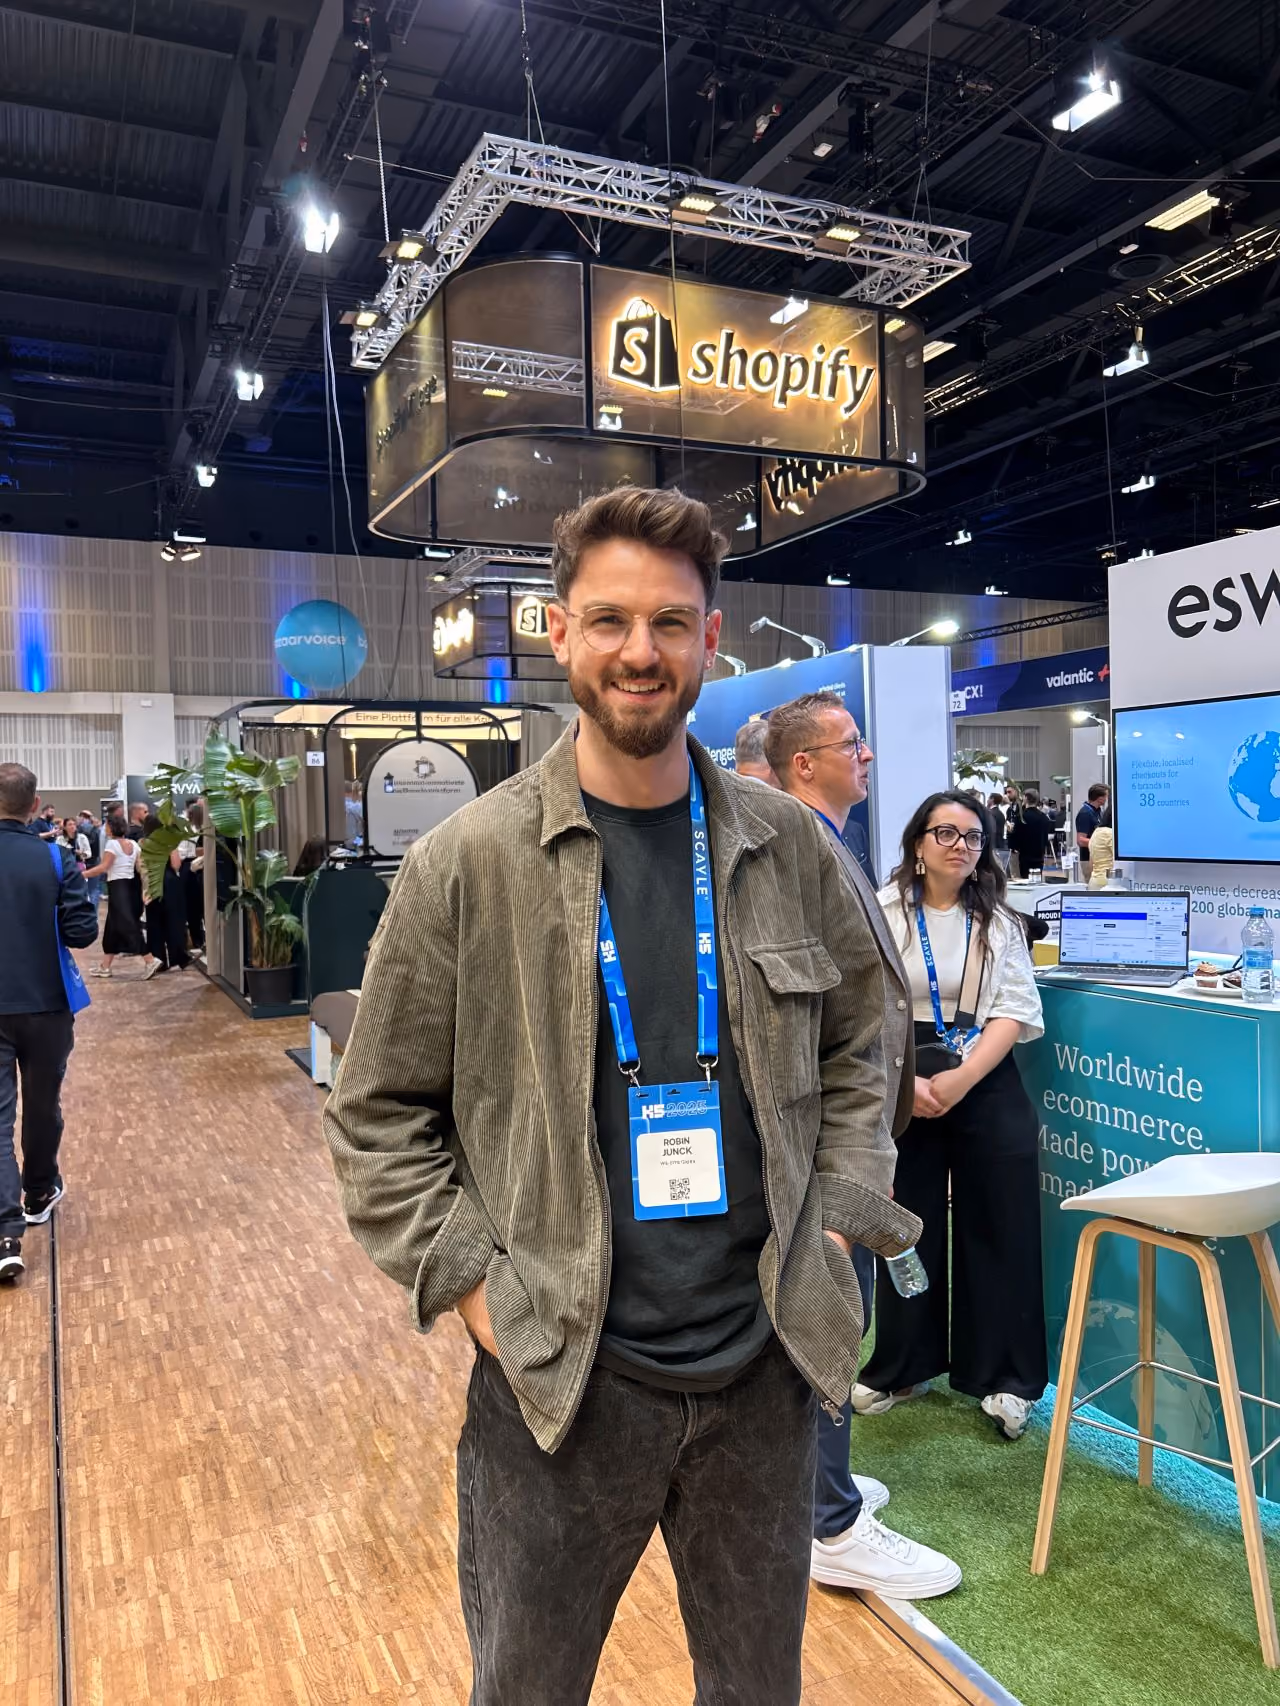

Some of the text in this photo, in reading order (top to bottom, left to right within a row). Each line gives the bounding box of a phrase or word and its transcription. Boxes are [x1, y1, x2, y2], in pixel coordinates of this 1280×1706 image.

[687, 328, 876, 419] shopify
[1046, 667, 1094, 688] valantic
[965, 684, 984, 699] CX!
[953, 700, 962, 710] 72
[355, 712, 379, 721] Eine
[436, 714, 451, 722] für
[454, 714, 471, 722] alle
[1138, 781, 1162, 790] brands
[1140, 793, 1155, 806] 38
[694, 830, 709, 896] SCAYLE
[1180, 883, 1230, 898] revenue,
[1191, 901, 1214, 914] 200
[1038, 912, 1058, 920] PROUD
[1054, 1043, 1203, 1102] Worldwide
[666, 1100, 708, 1118] 2025
[1043, 1089, 1211, 1153] ecommerce.
[663, 1137, 690, 1146] ROBIN
[662, 1146, 693, 1157] JUNCK
